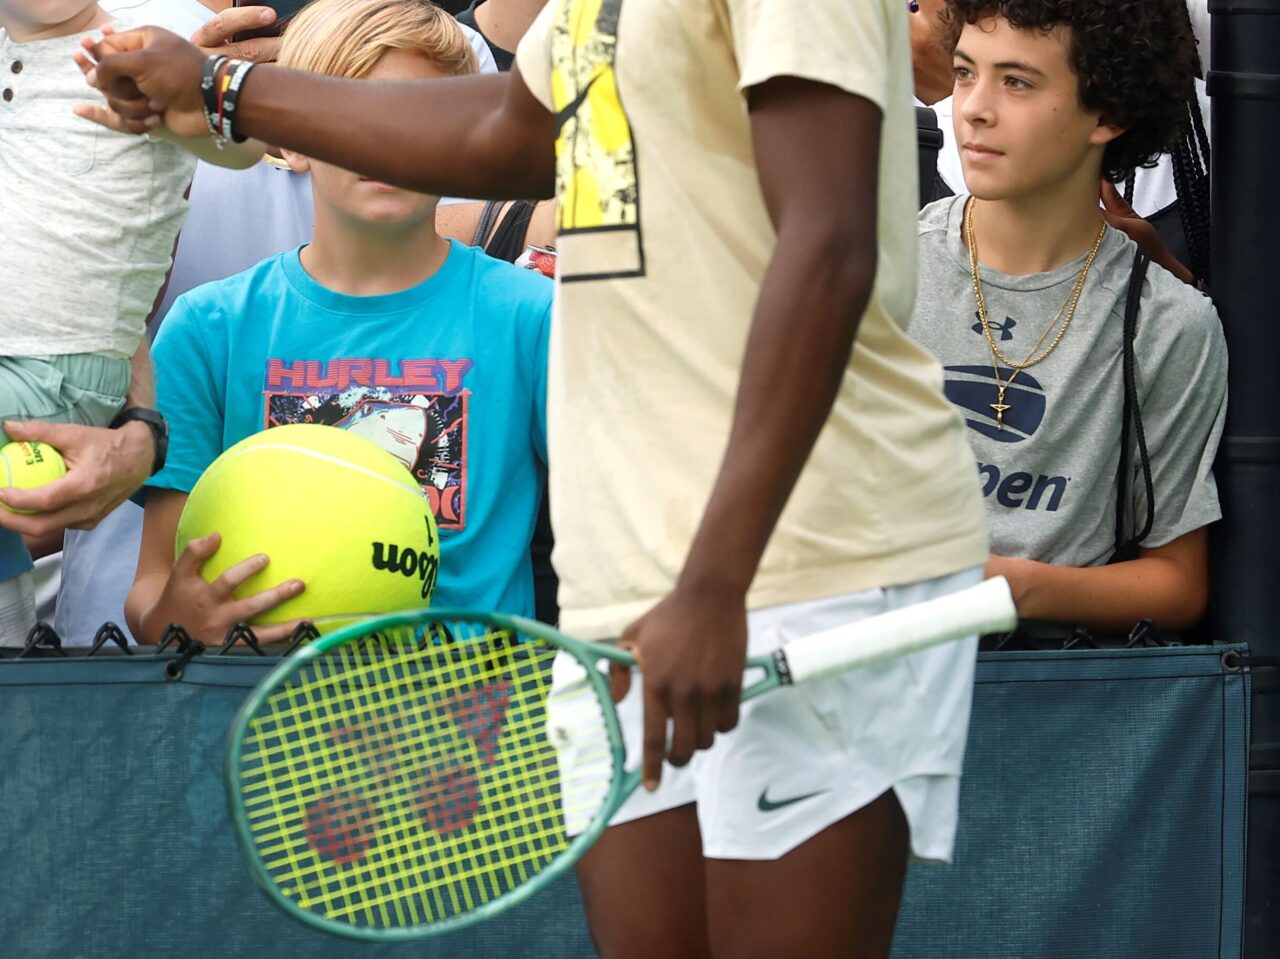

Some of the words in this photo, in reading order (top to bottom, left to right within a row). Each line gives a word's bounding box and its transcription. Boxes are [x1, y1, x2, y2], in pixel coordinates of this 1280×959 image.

[267, 358, 474, 394] HURLEY
[976, 462, 1067, 512] pen
[372, 542, 438, 599] lson
